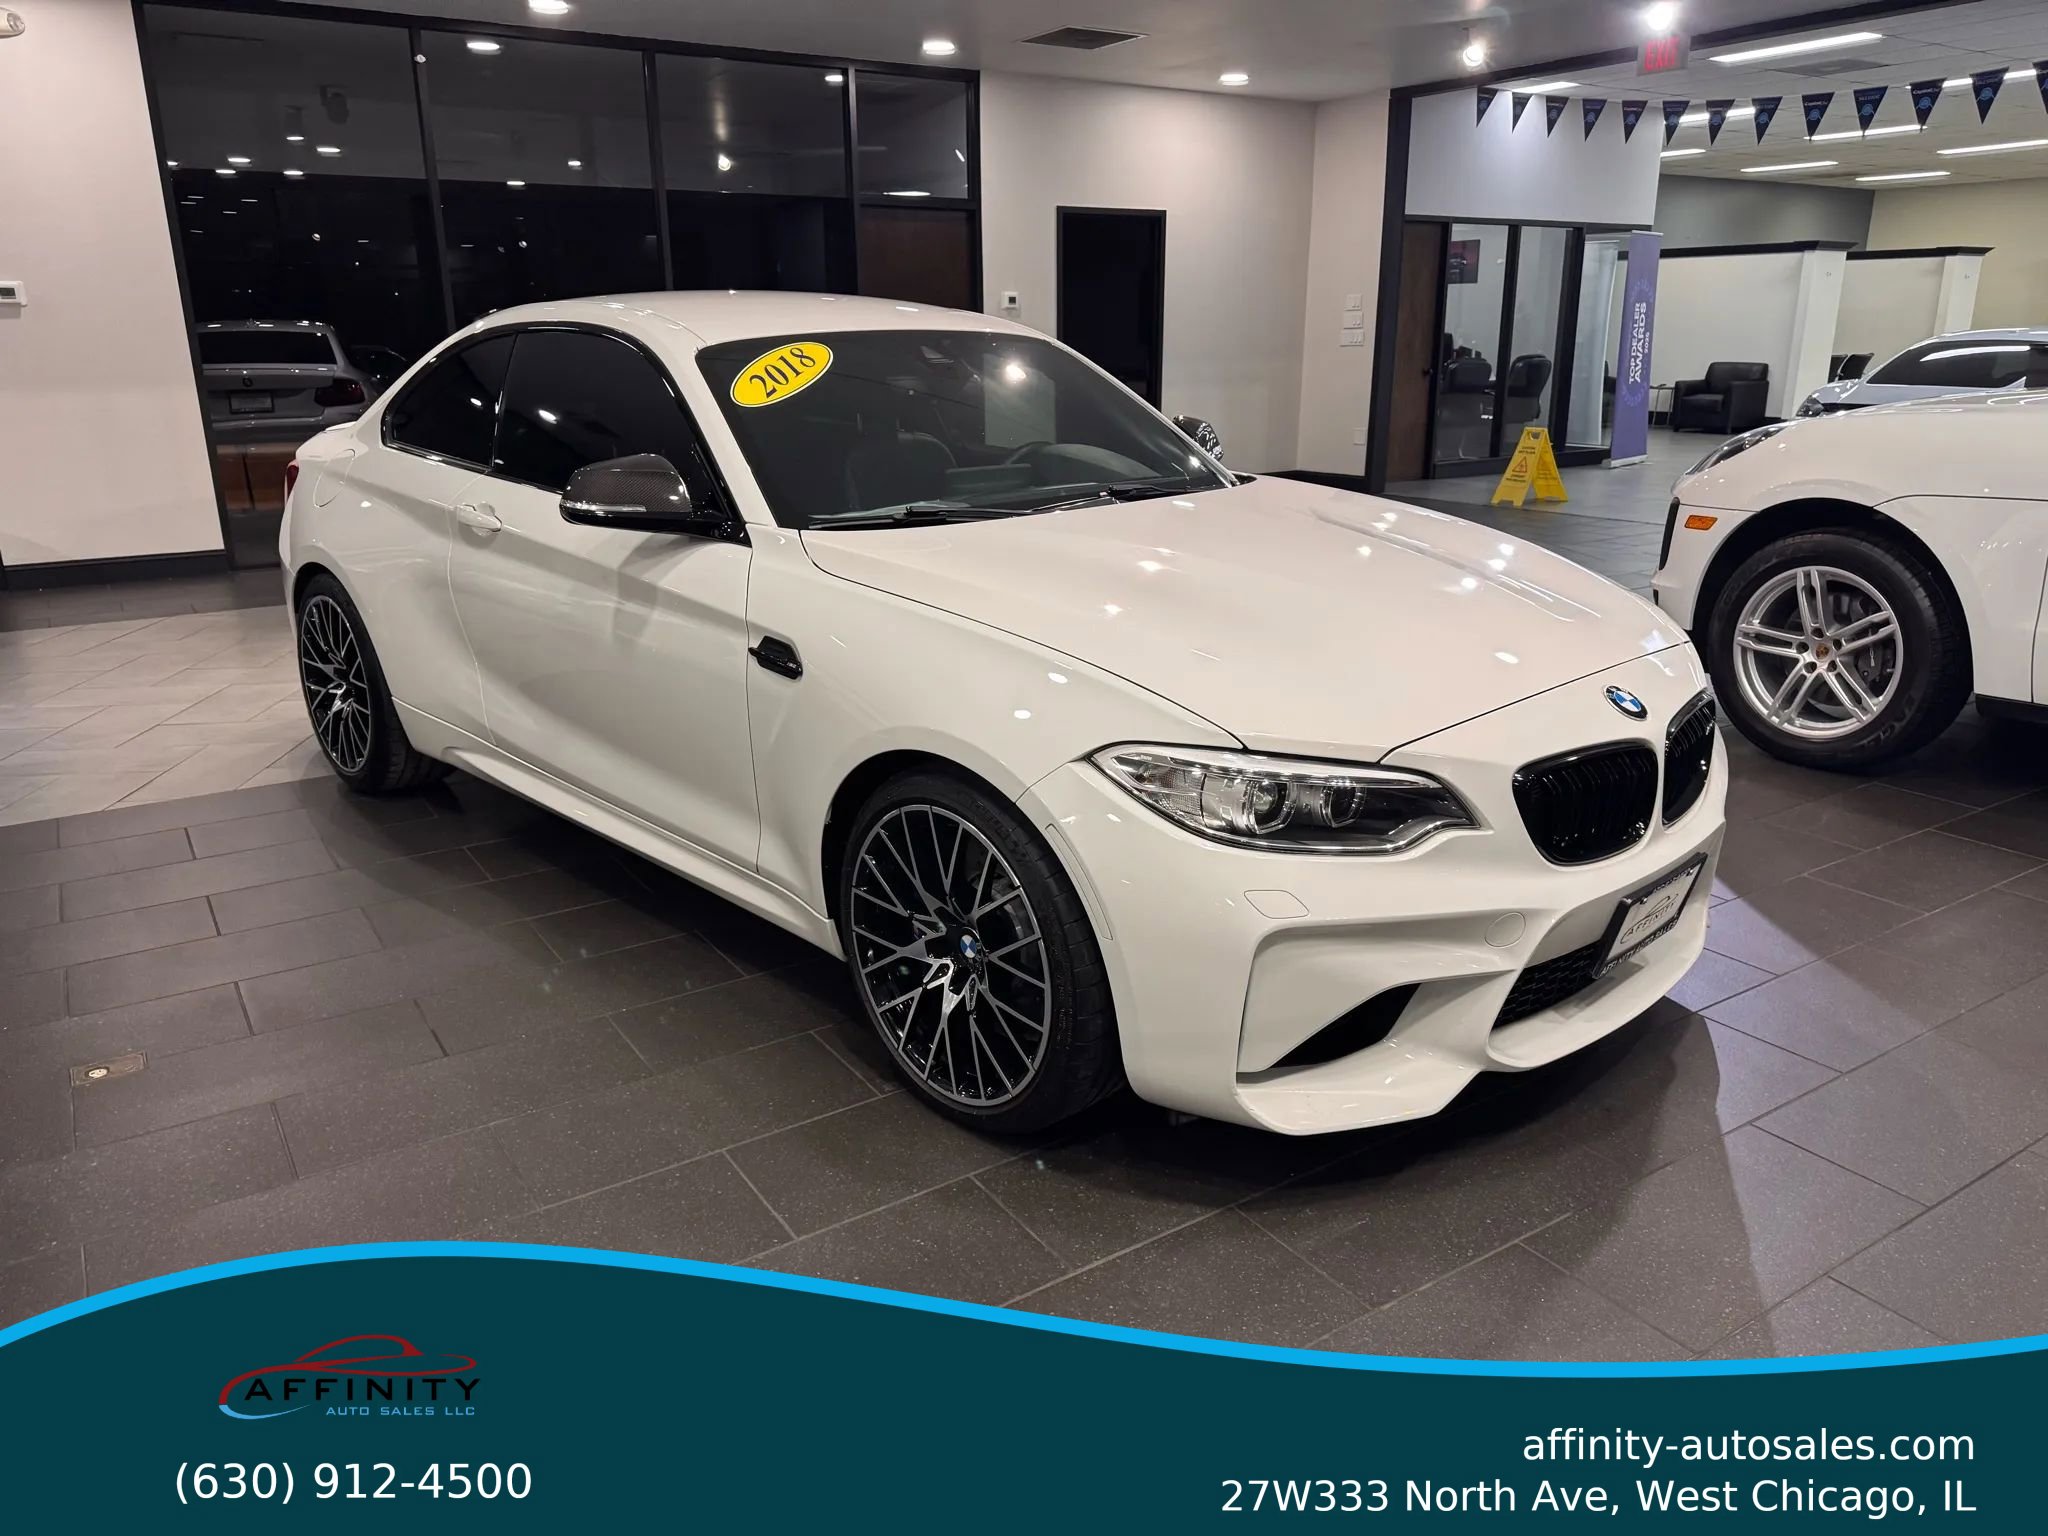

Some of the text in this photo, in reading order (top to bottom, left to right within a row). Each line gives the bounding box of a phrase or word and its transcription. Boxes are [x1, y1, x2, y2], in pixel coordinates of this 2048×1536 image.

[1644, 37, 1680, 72] EXIT
[1631, 302, 1640, 356] DEALER
[1634, 301, 1646, 383] AWARDS
[749, 347, 816, 399] 2018
